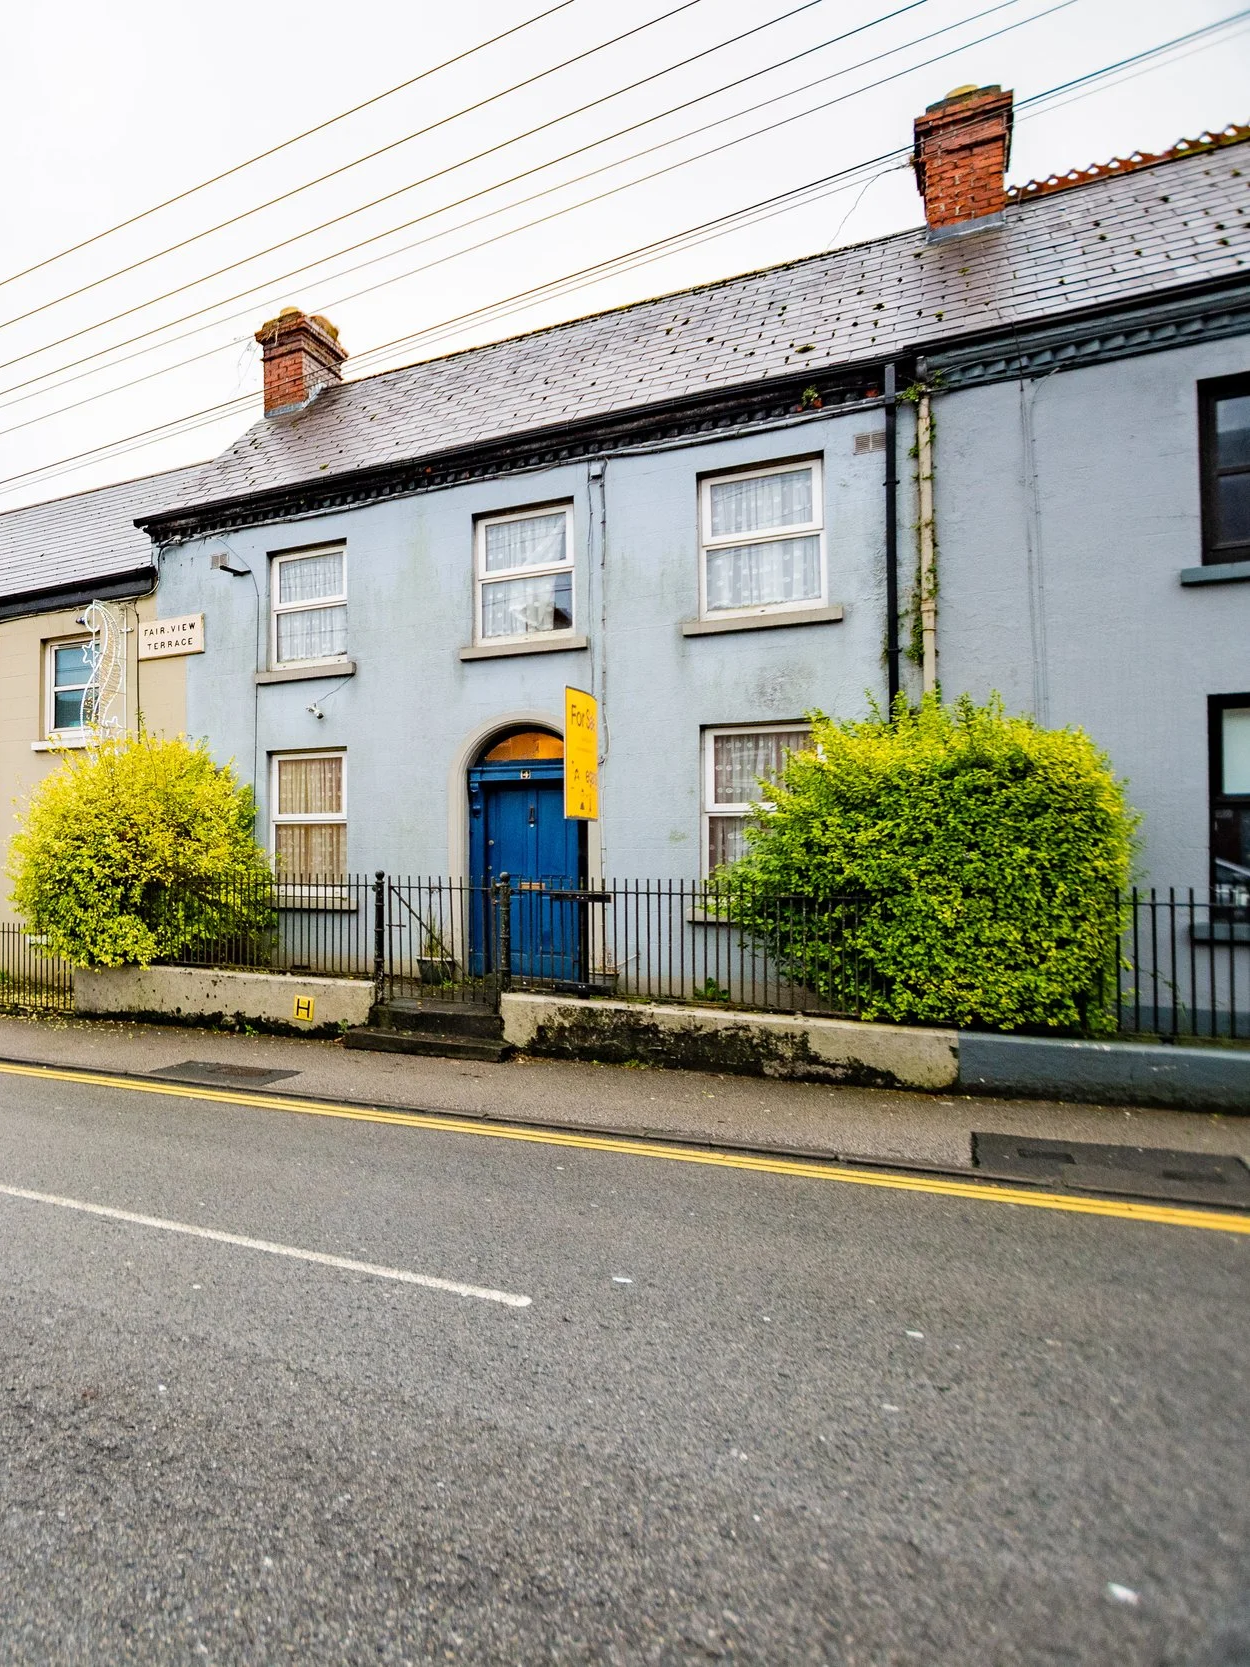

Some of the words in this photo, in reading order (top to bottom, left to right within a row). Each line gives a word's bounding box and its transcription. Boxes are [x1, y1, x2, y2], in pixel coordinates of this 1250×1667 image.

[147, 637, 194, 650] TERRACE
[571, 703, 585, 728] For
[296, 998, 311, 1018] H
